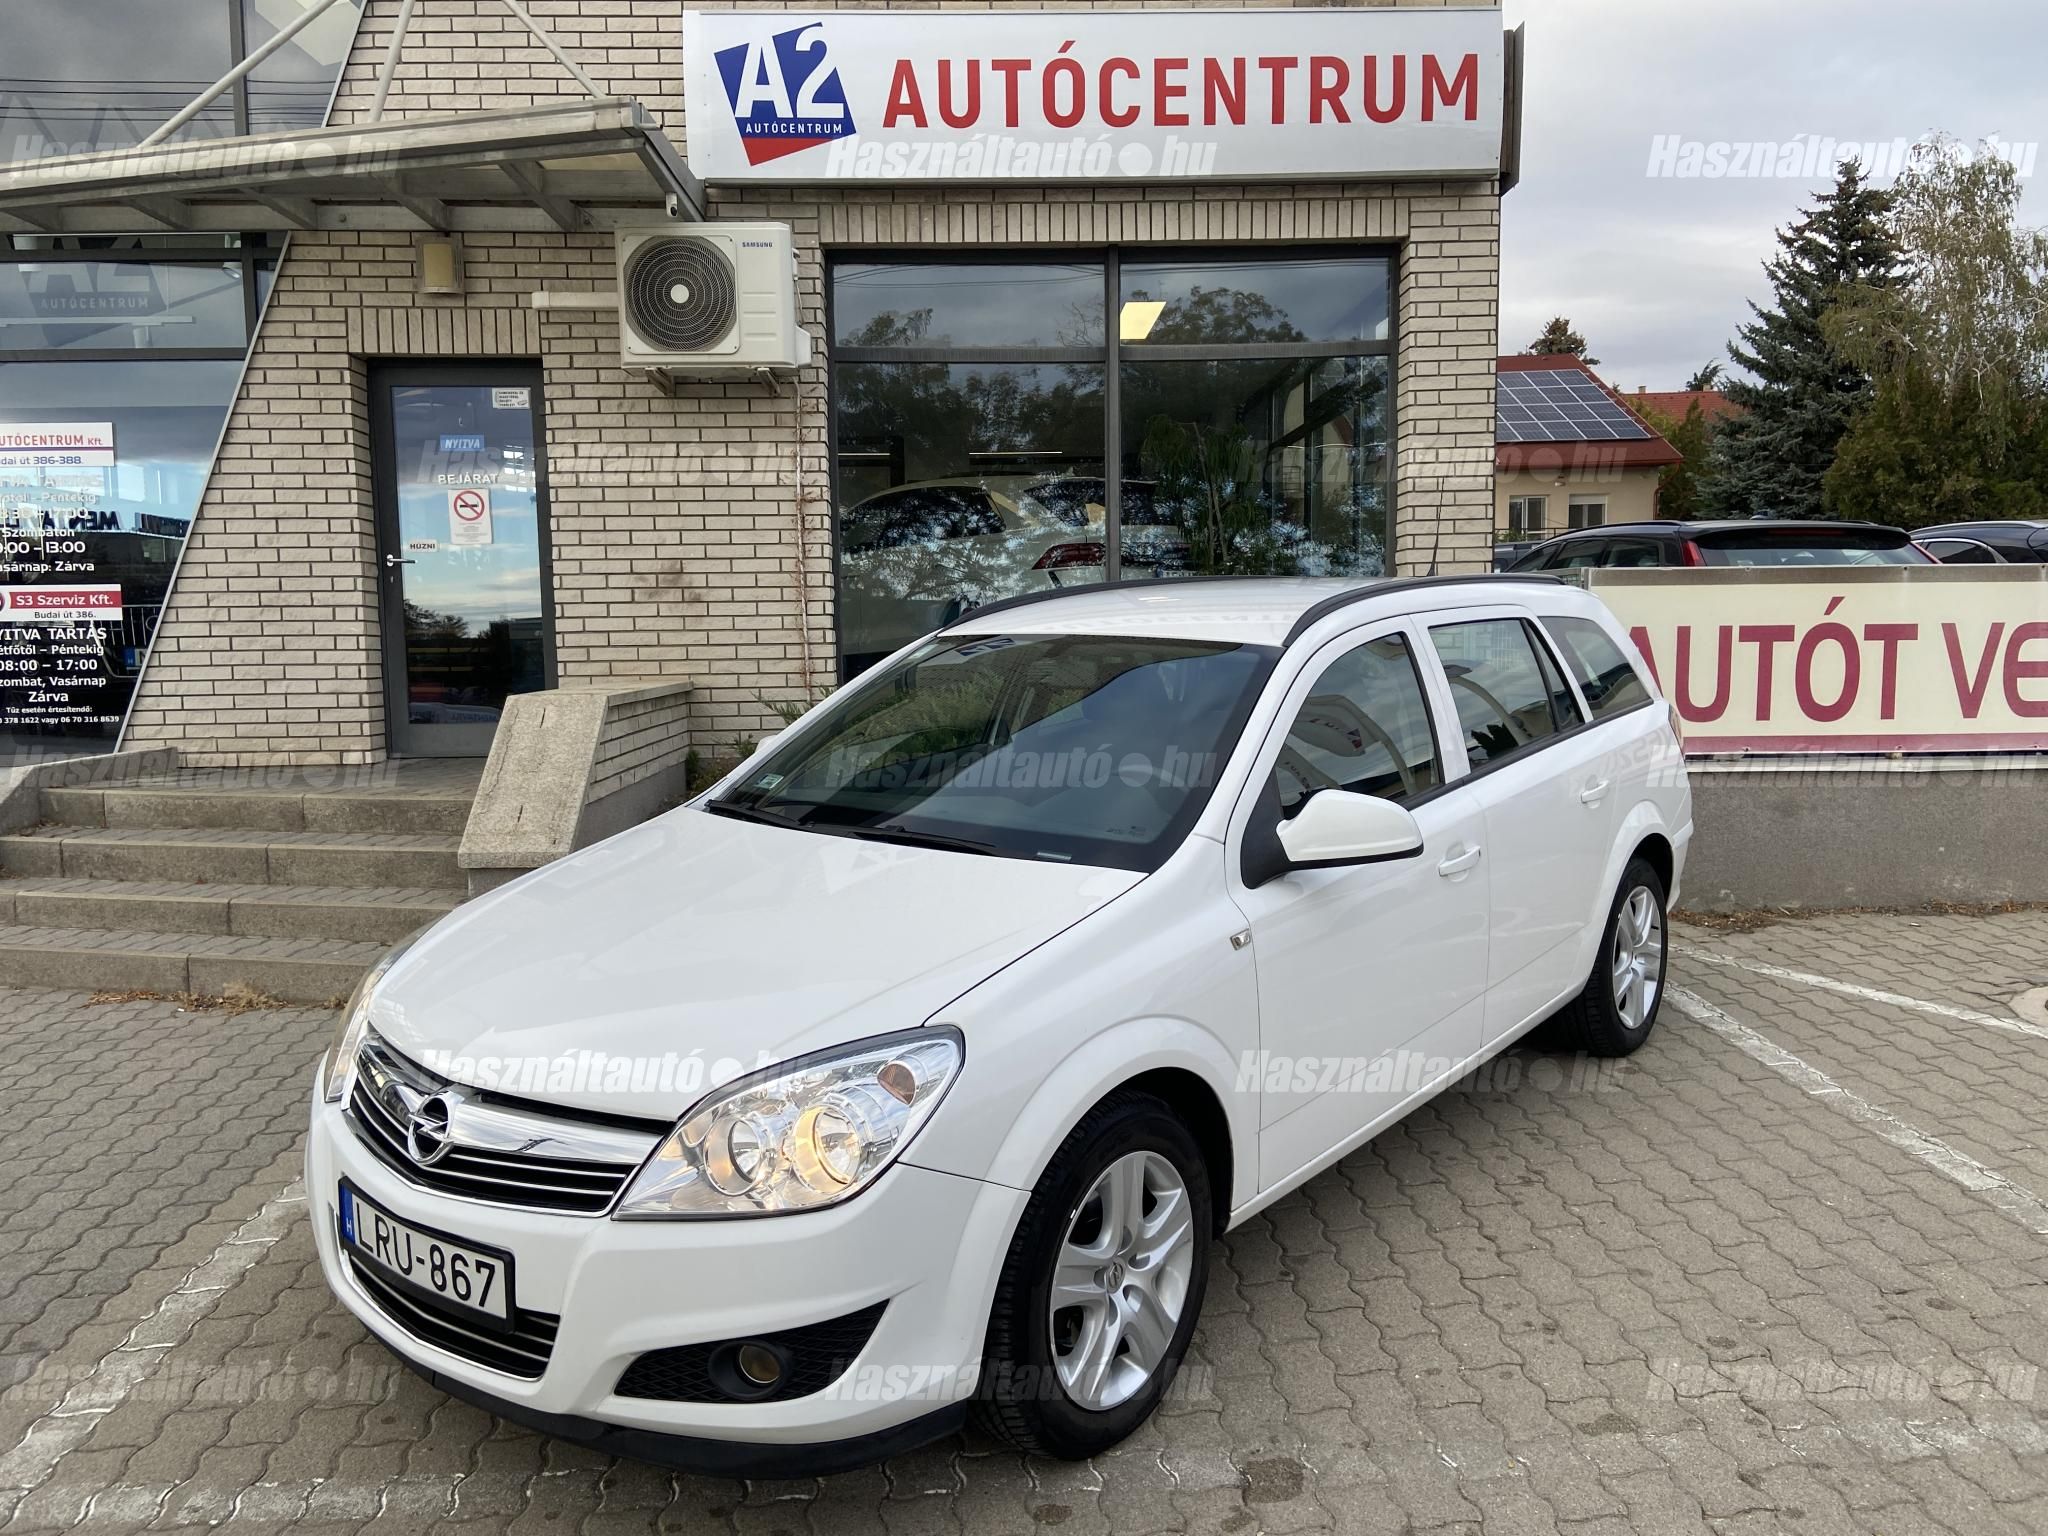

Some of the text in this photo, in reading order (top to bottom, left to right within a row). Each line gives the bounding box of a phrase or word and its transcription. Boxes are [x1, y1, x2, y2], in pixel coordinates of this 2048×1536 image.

[735, 26, 844, 118] A2
[882, 40, 1479, 128] AUTÓCENTRUM
[745, 121, 843, 134] AUTÓCENTRUM
[40, 296, 149, 310] AUTÓCENTRUM
[444, 439, 481, 449] NYITVA
[437, 472, 498, 484] BEJÁRAT
[2, 528, 75, 537] Szombaton
[45, 541, 86, 553] 13:00
[54, 560, 95, 572] Zárva
[16, 595, 33, 606] S3
[37, 595, 85, 605] Szerviz
[89, 593, 113, 605] Kft.
[34, 611, 96, 619] Budai út 386.
[47, 627, 107, 640] TARTÁS
[51, 644, 104, 656] Péntekig
[56, 659, 98, 670] 17:00
[49, 676, 106, 687] Vasárnap
[28, 690, 69, 702] Zárva
[345, 1201, 497, 1308] H LRU-867
